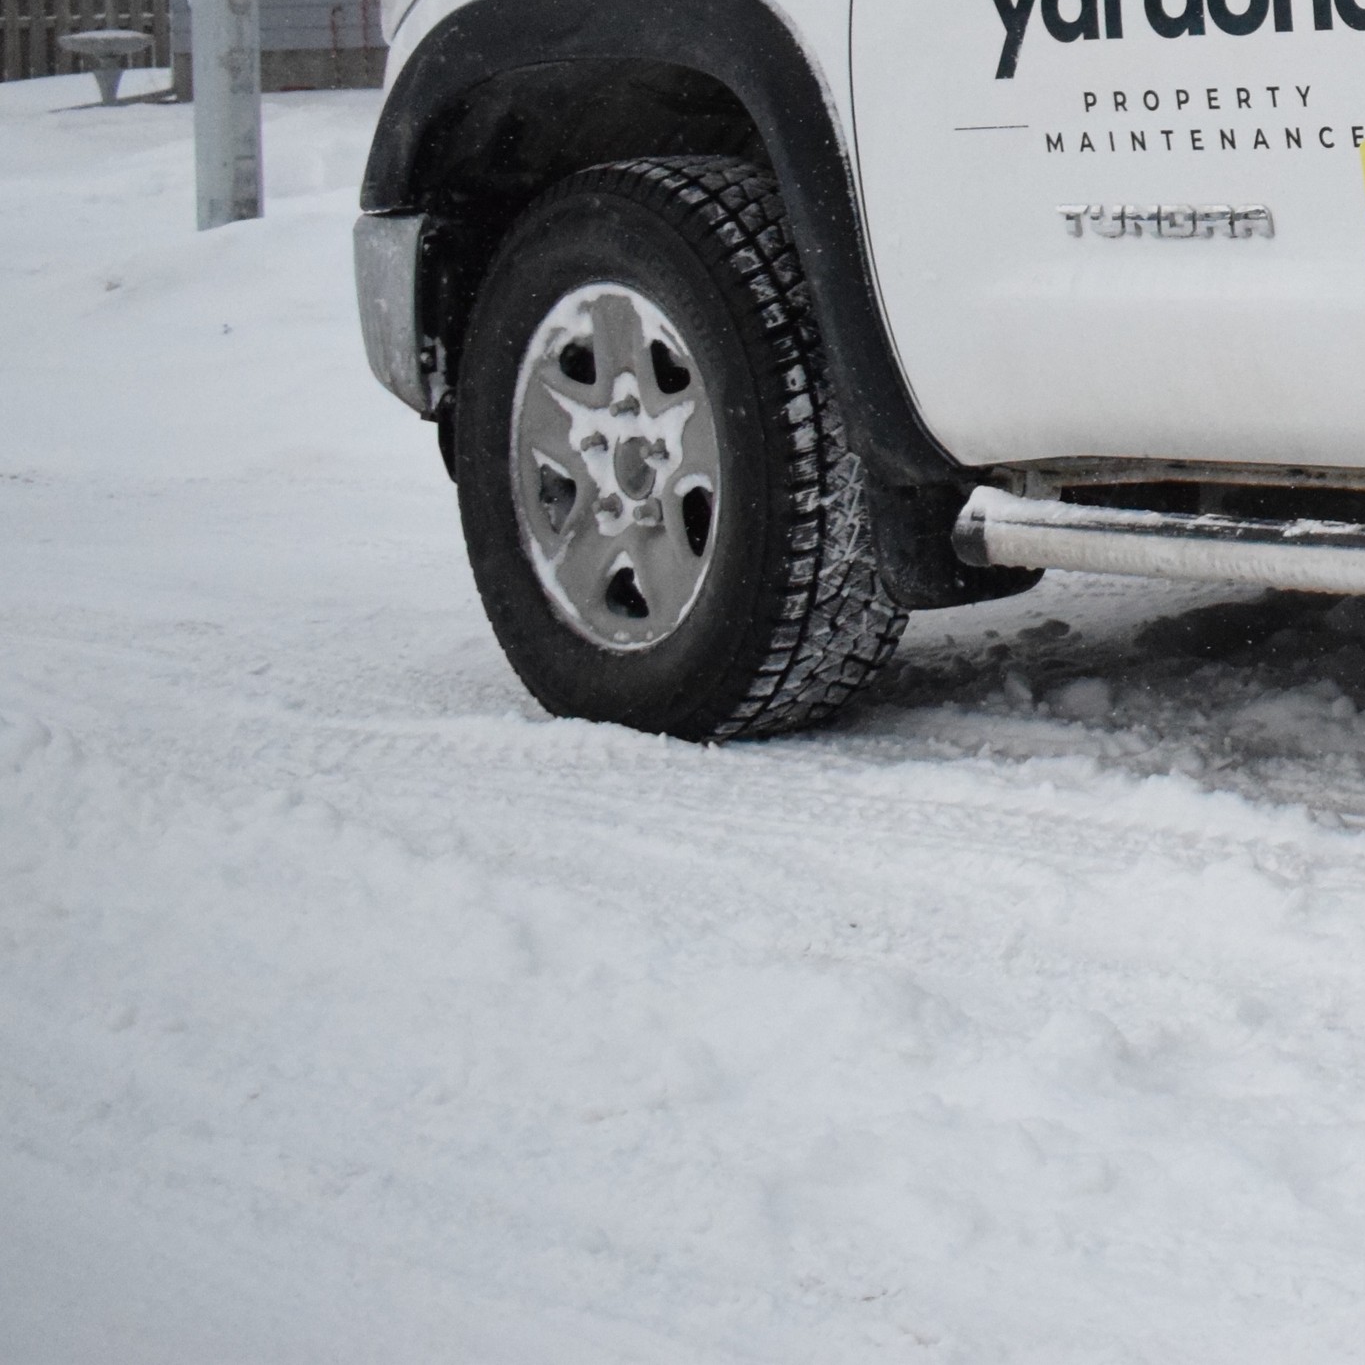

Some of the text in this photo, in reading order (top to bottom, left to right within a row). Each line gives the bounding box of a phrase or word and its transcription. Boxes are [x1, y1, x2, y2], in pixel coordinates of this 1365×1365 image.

[1083, 85, 1311, 113] PROPERTY
[1045, 125, 1365, 153] MAINTENANCE
[1055, 203, 1275, 239] TUNDRA
